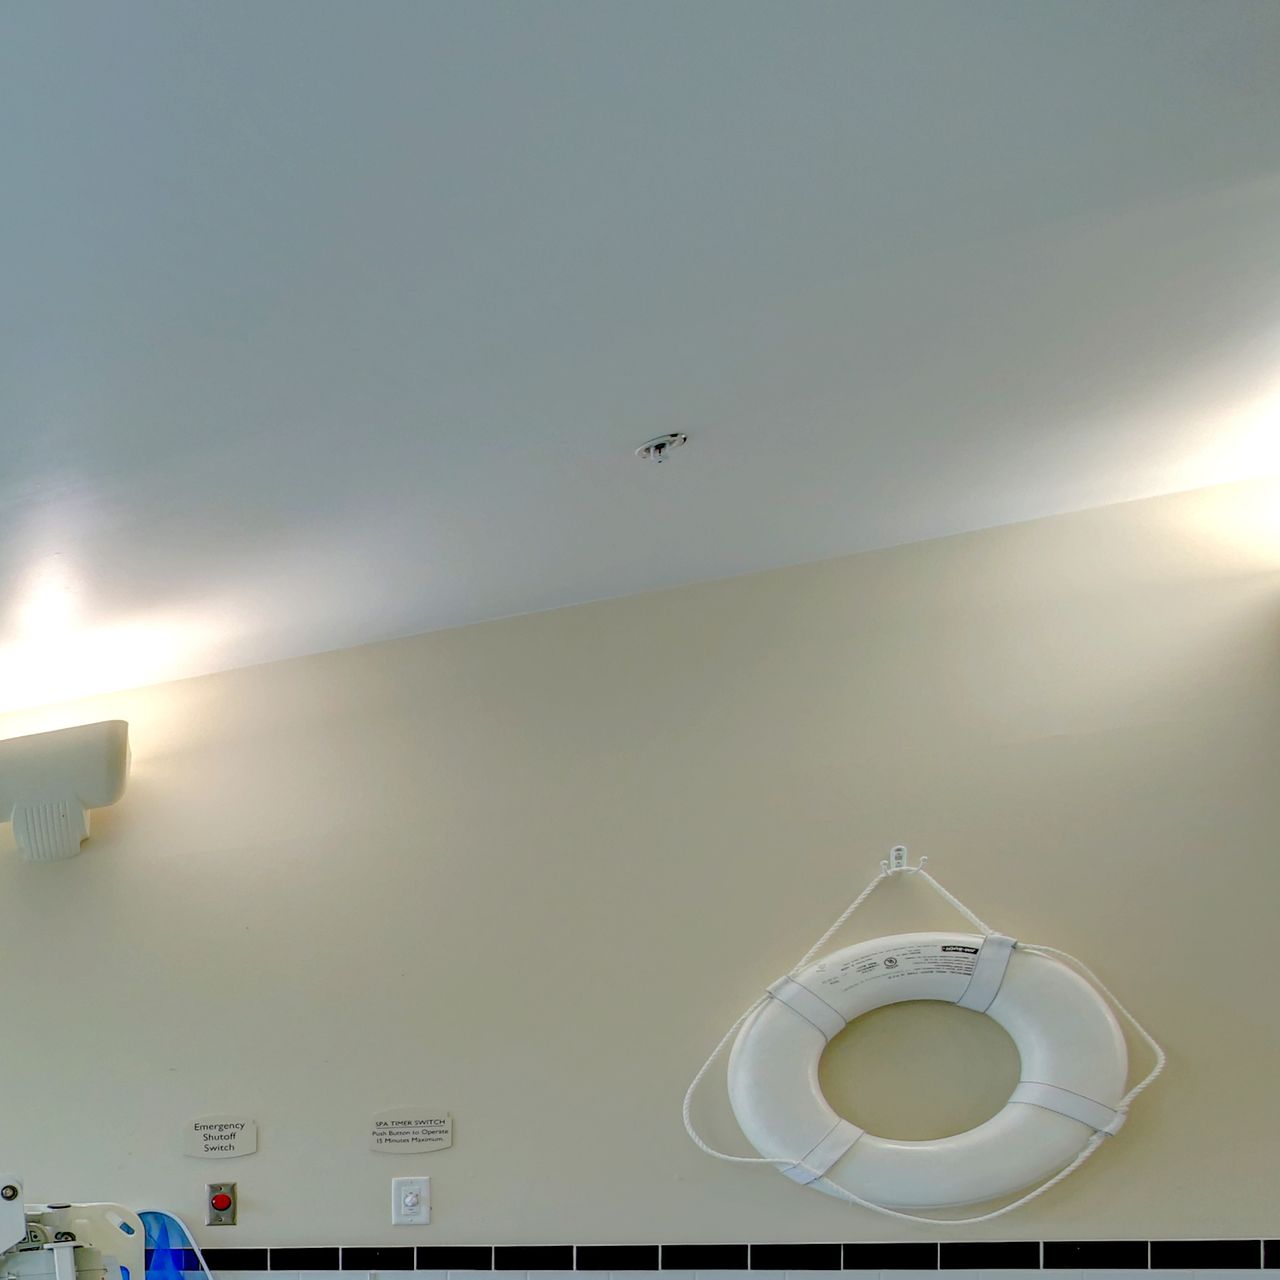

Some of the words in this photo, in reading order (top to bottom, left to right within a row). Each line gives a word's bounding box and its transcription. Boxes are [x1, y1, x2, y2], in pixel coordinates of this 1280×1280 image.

[194, 1122, 246, 1132] Emergency
[421, 1128, 449, 1136] Operate
[203, 1132, 237, 1142] Shutoff
[204, 1143, 235, 1152] Switch
